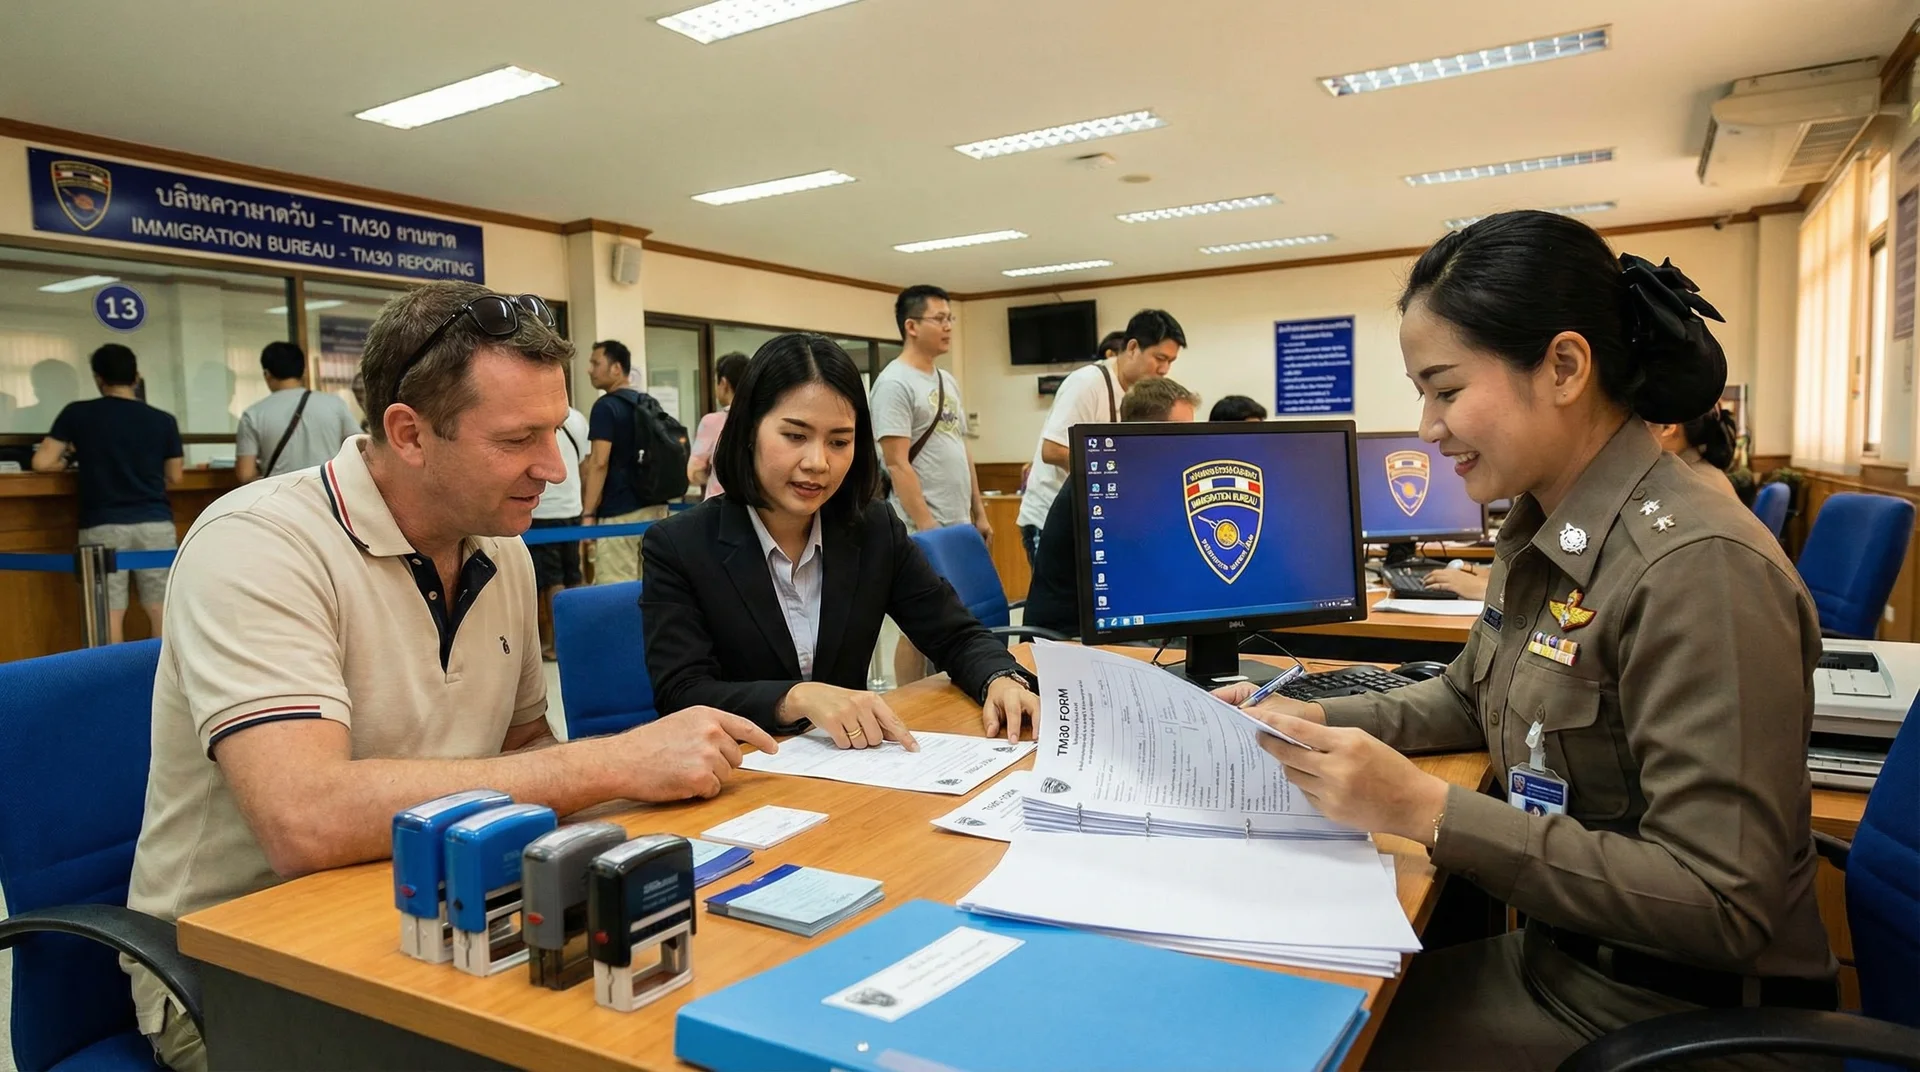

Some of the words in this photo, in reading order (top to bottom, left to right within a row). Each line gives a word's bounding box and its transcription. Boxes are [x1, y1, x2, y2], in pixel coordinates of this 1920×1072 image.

[338, 214, 391, 240] TM30
[132, 215, 262, 251] IMMIGRATION
[267, 236, 335, 260] BUREAU
[350, 247, 393, 267] TM30
[397, 253, 475, 278] REPORTING
[104, 296, 138, 320] 13
[1057, 688, 1071, 722] FORM
[1056, 724, 1071, 757] TM30
